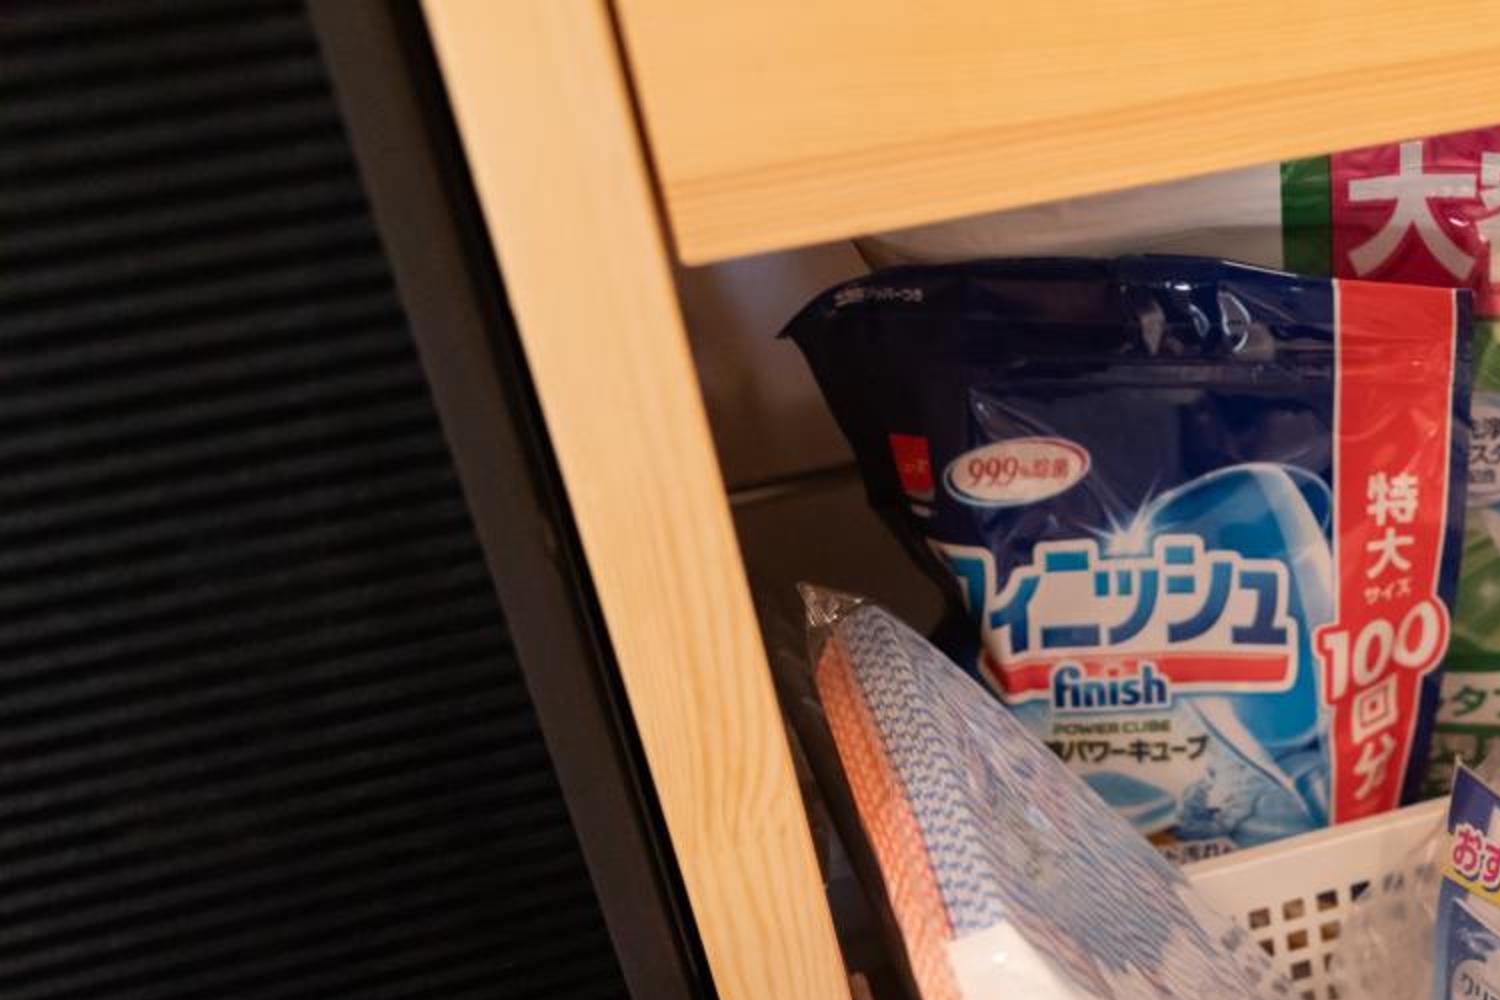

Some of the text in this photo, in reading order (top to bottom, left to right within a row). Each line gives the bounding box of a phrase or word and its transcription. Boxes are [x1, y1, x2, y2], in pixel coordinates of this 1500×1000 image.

[1366, 470, 1419, 580] 特大
[1363, 577, 1413, 606] サイズ
[1323, 600, 1441, 701] 100
[1053, 665, 1168, 709] finish
[1053, 719, 1172, 735] POWER CUBE
[1351, 672, 1398, 802] 回分
